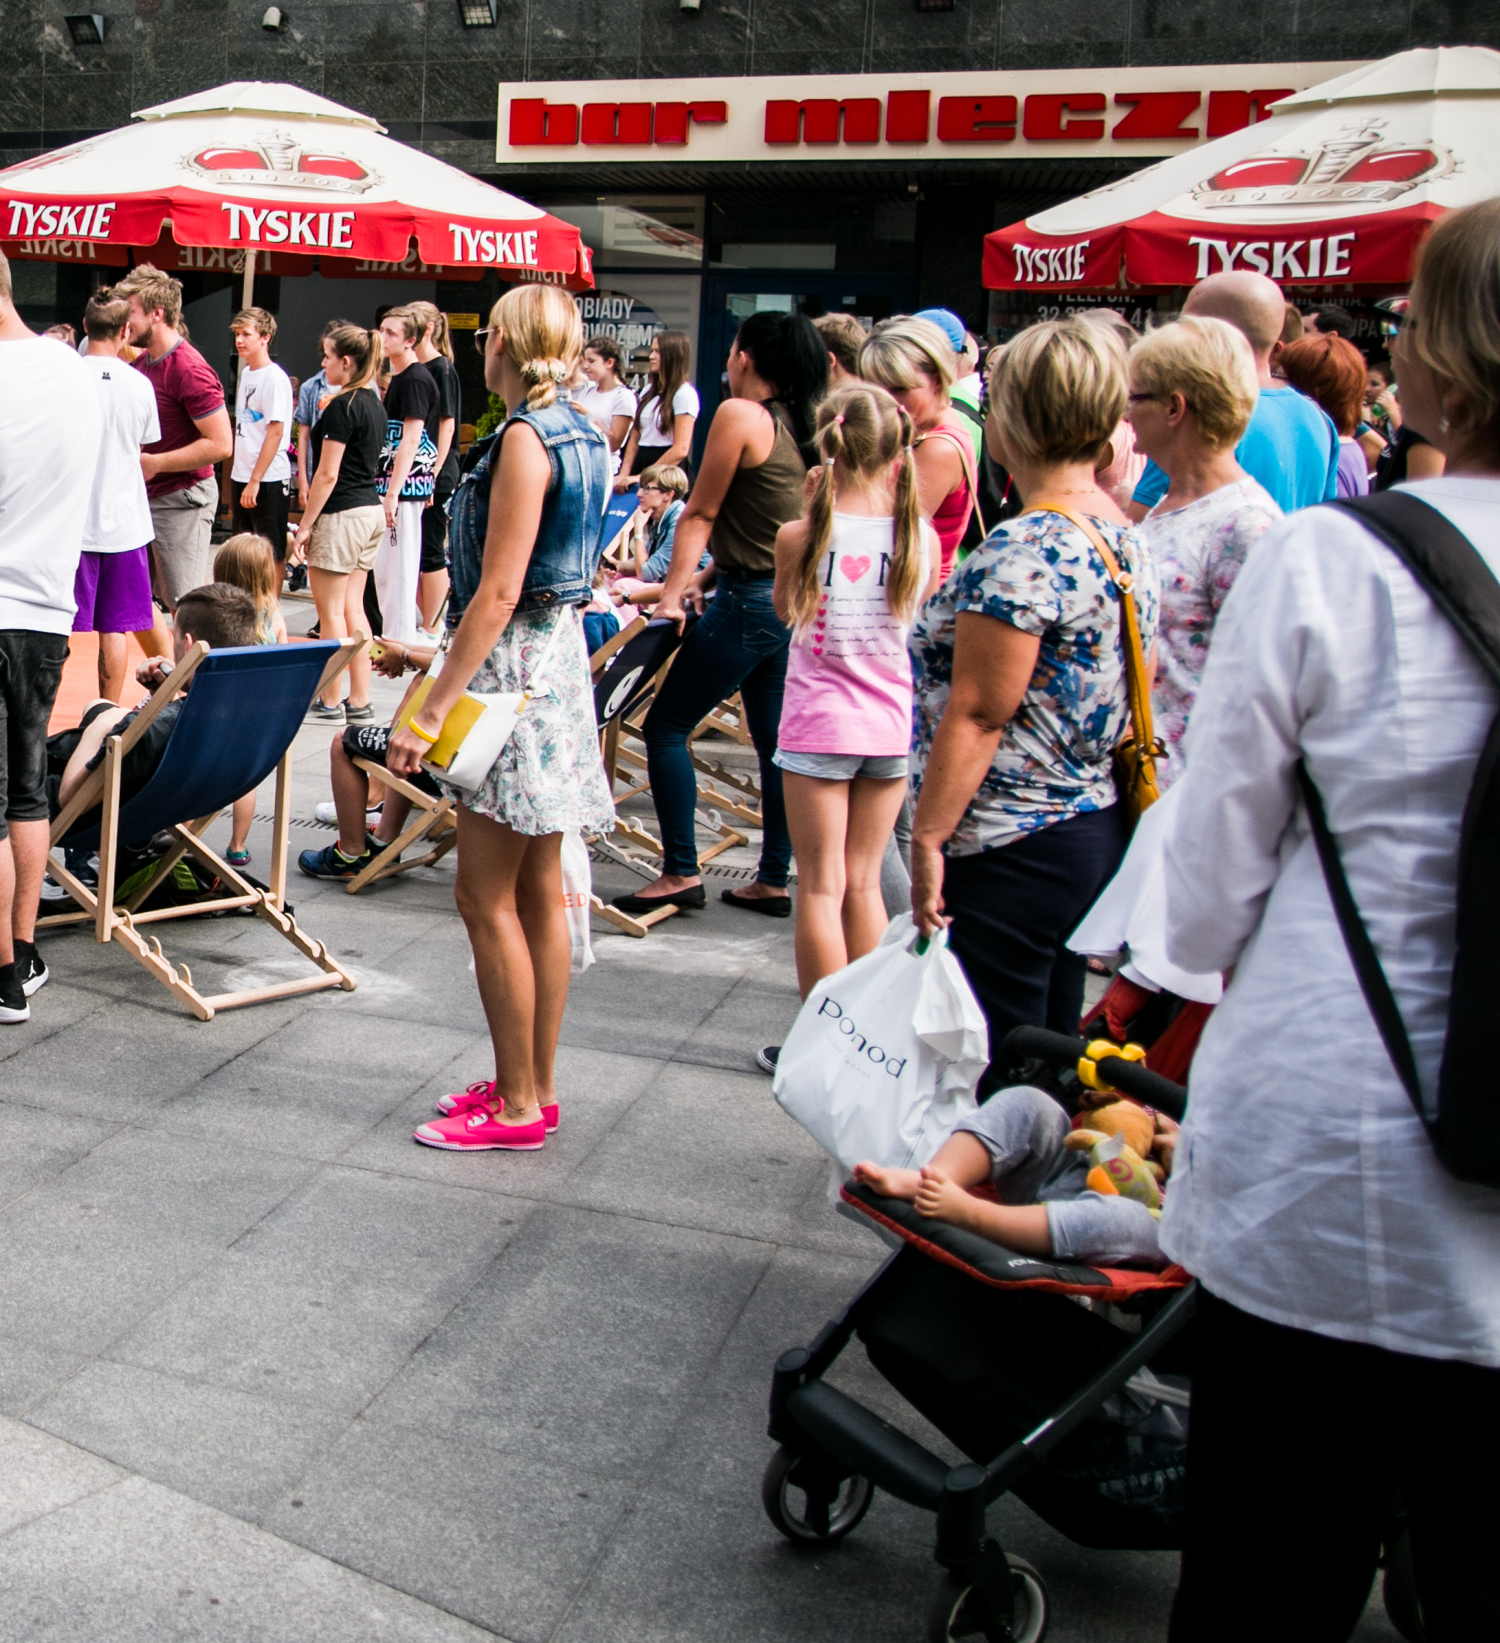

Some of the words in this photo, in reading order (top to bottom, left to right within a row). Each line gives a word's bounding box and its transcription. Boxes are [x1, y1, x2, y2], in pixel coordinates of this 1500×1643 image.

[509, 98, 729, 145] bar
[764, 90, 1300, 144] mleczn
[8, 200, 116, 238] TYSKIE
[221, 202, 356, 249] TYSKIE
[449, 223, 538, 266] TYSKIE
[1012, 239, 1090, 283] TYSKIE
[1189, 232, 1356, 280] TYSKIE
[575, 297, 634, 320] OBIADY
